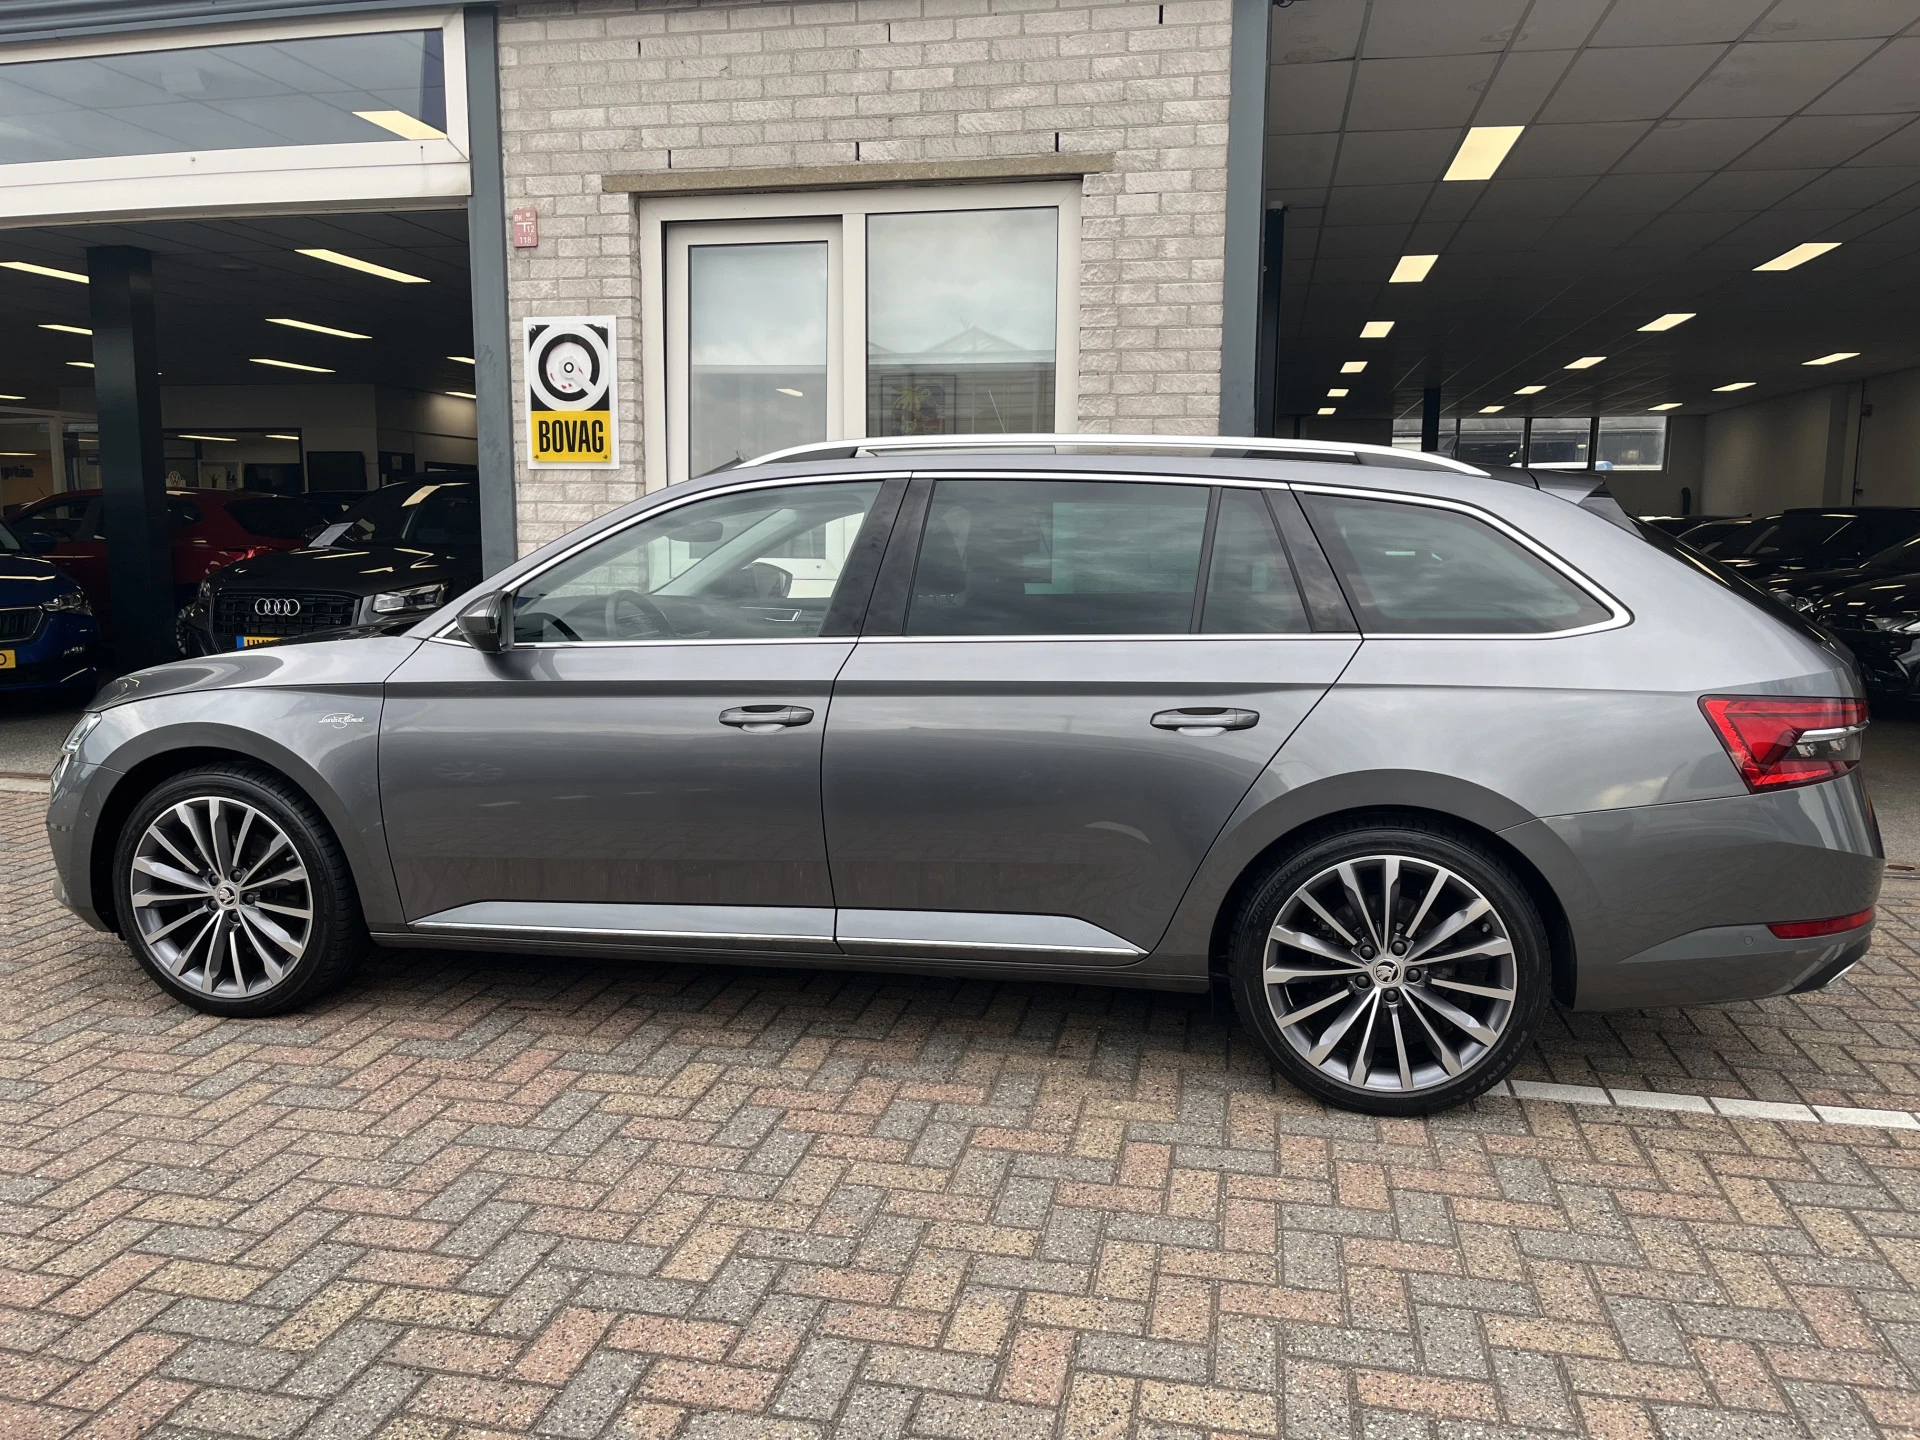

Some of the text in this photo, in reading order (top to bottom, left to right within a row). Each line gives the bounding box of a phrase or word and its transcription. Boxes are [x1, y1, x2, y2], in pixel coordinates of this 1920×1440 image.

[514, 214, 523, 222] BK
[519, 236, 532, 244] 118
[538, 419, 604, 453] BOVAG
